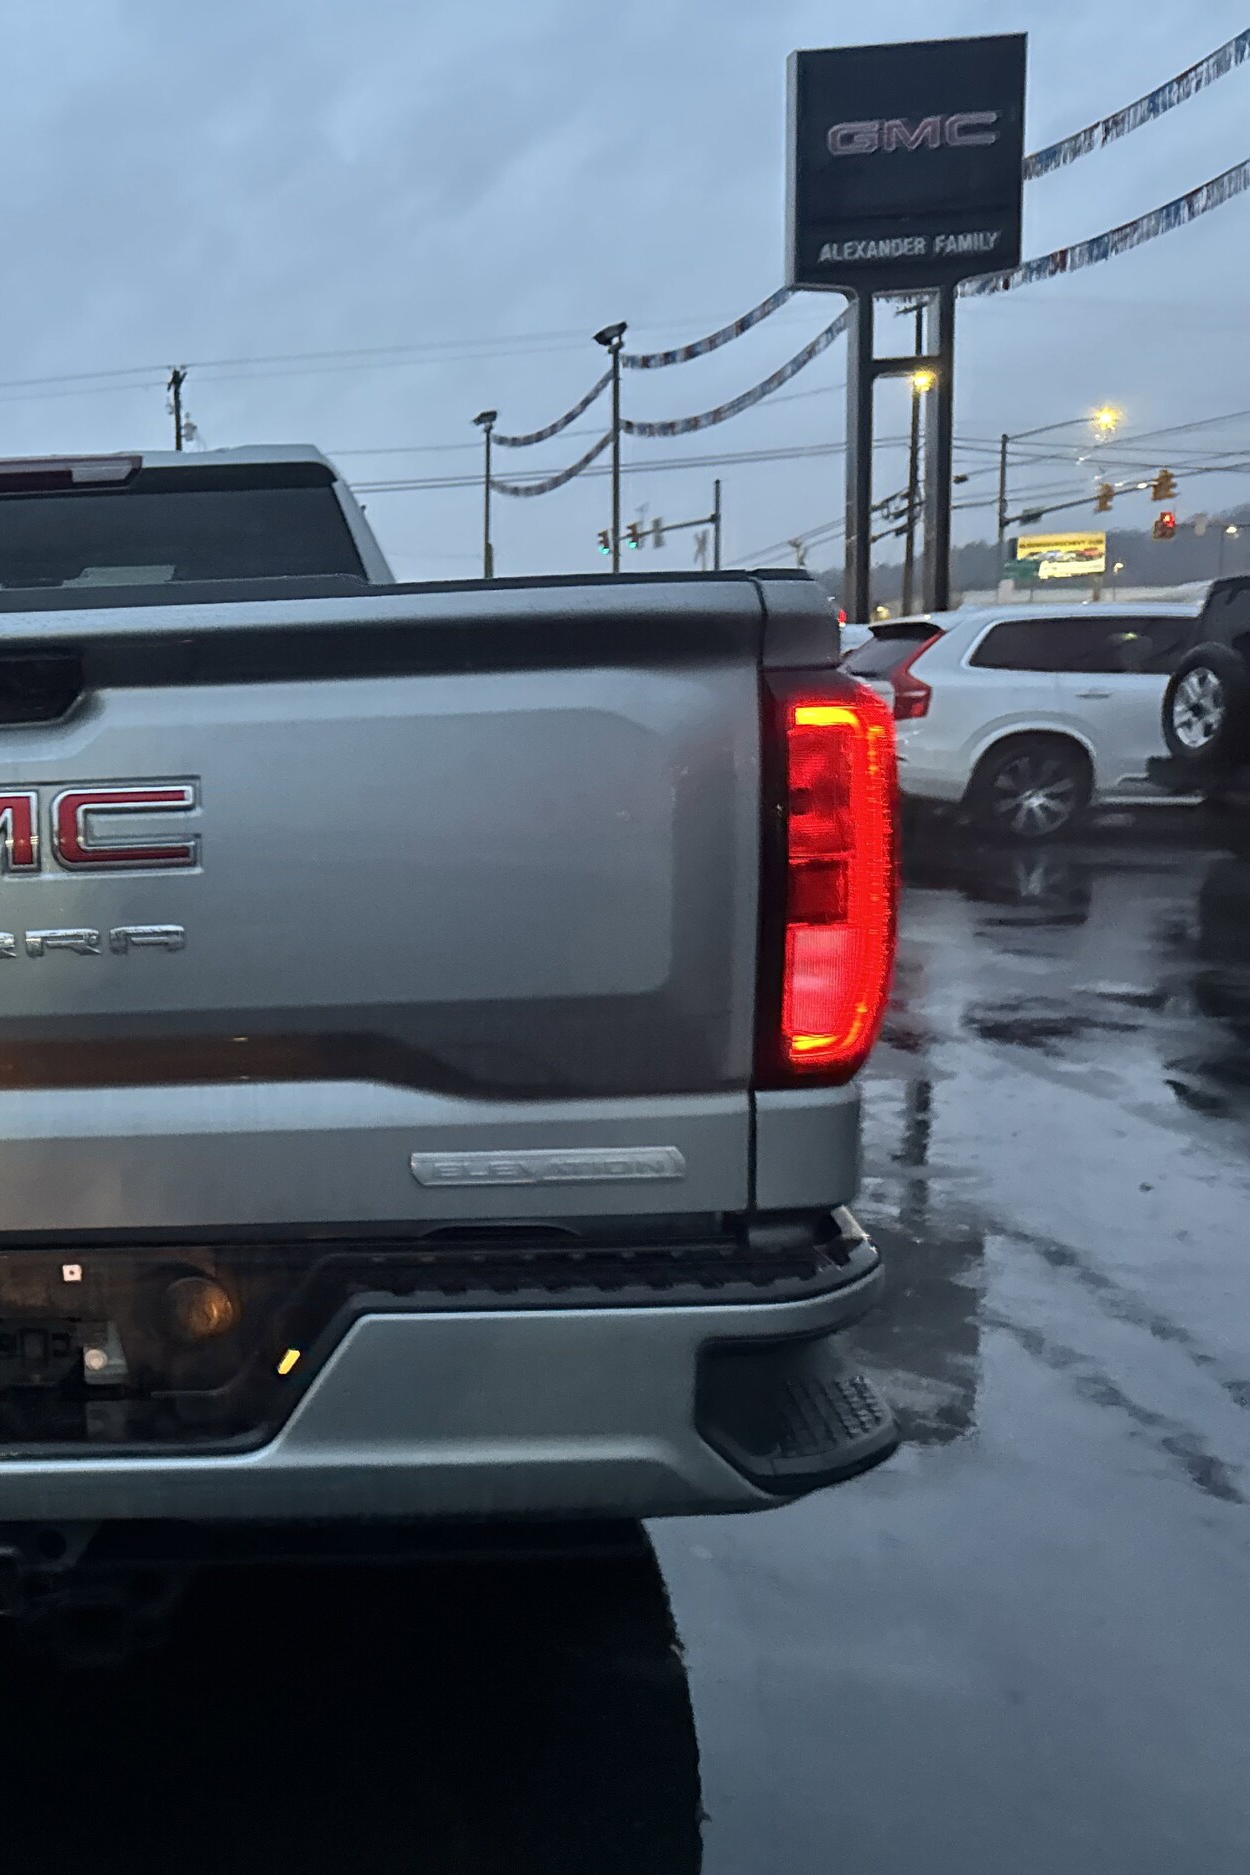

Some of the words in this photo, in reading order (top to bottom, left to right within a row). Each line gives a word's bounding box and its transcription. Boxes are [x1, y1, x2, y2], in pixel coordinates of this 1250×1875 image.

[827, 110, 999, 156] GMC
[819, 236, 926, 263] ALEXANDER
[934, 230, 999, 254] FAMILY
